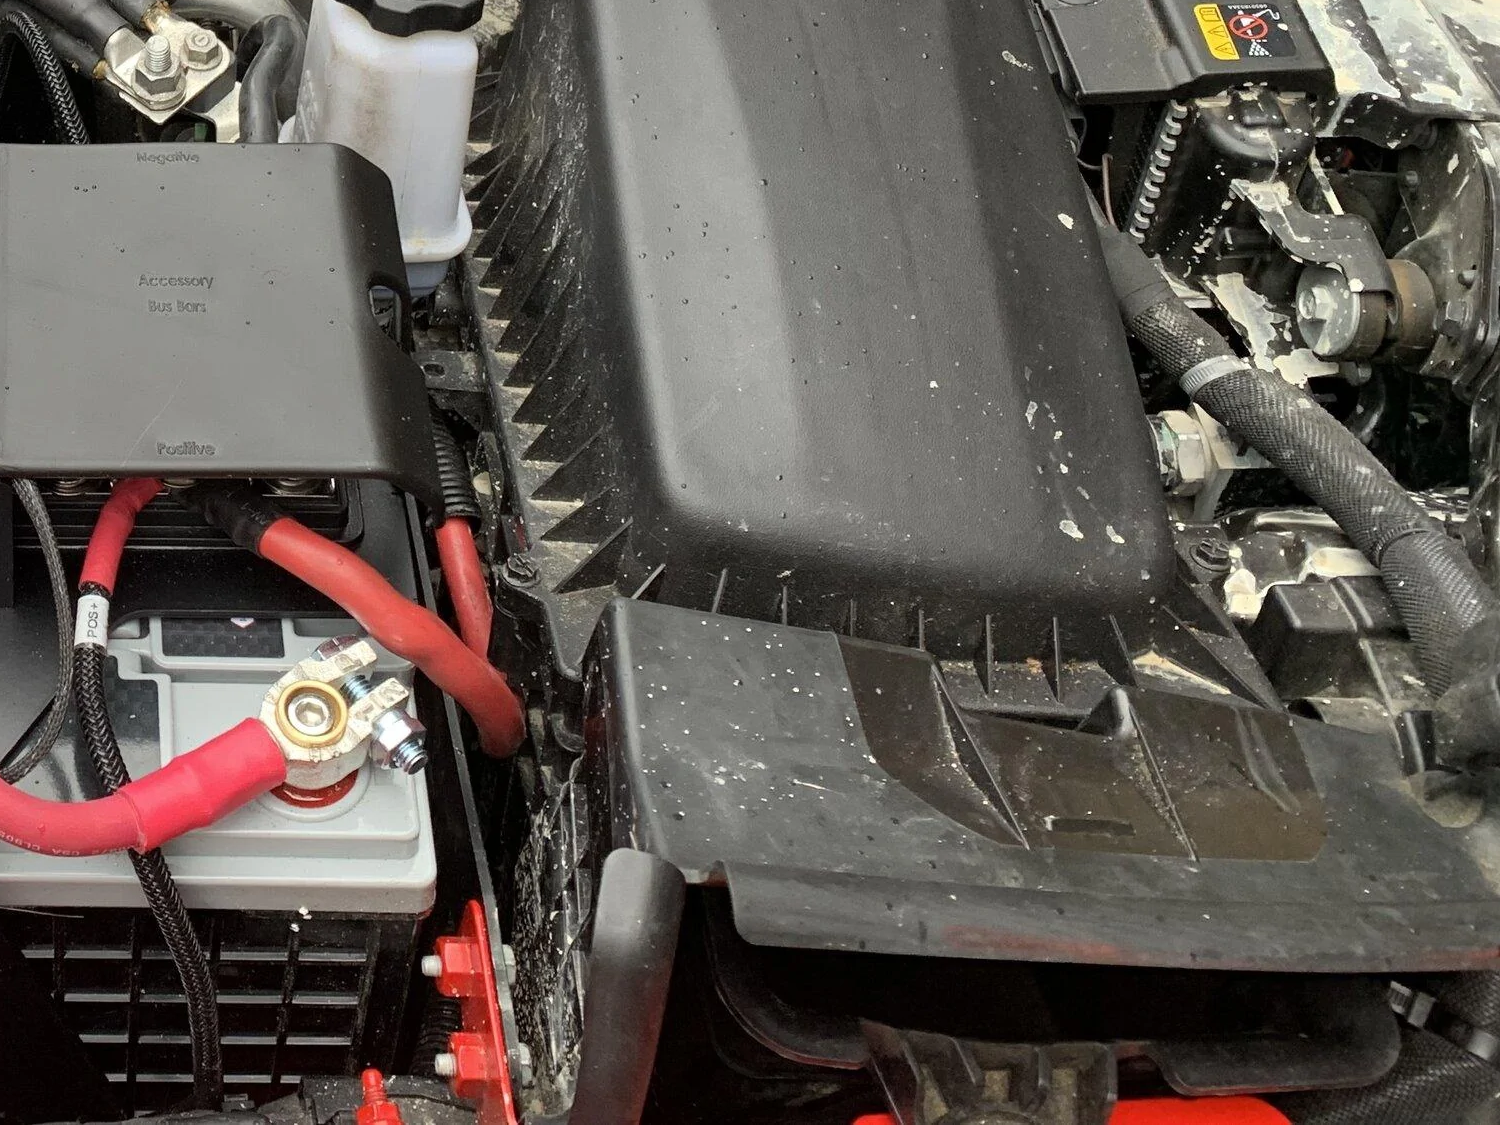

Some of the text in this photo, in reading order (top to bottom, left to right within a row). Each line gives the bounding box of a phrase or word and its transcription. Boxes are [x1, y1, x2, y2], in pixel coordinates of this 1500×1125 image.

[136, 151, 201, 165] Negative
[138, 274, 214, 289] Accessory
[148, 299, 207, 313] Bus Bars
[156, 441, 216, 456] Positive
[87, 602, 99, 638] POS+
